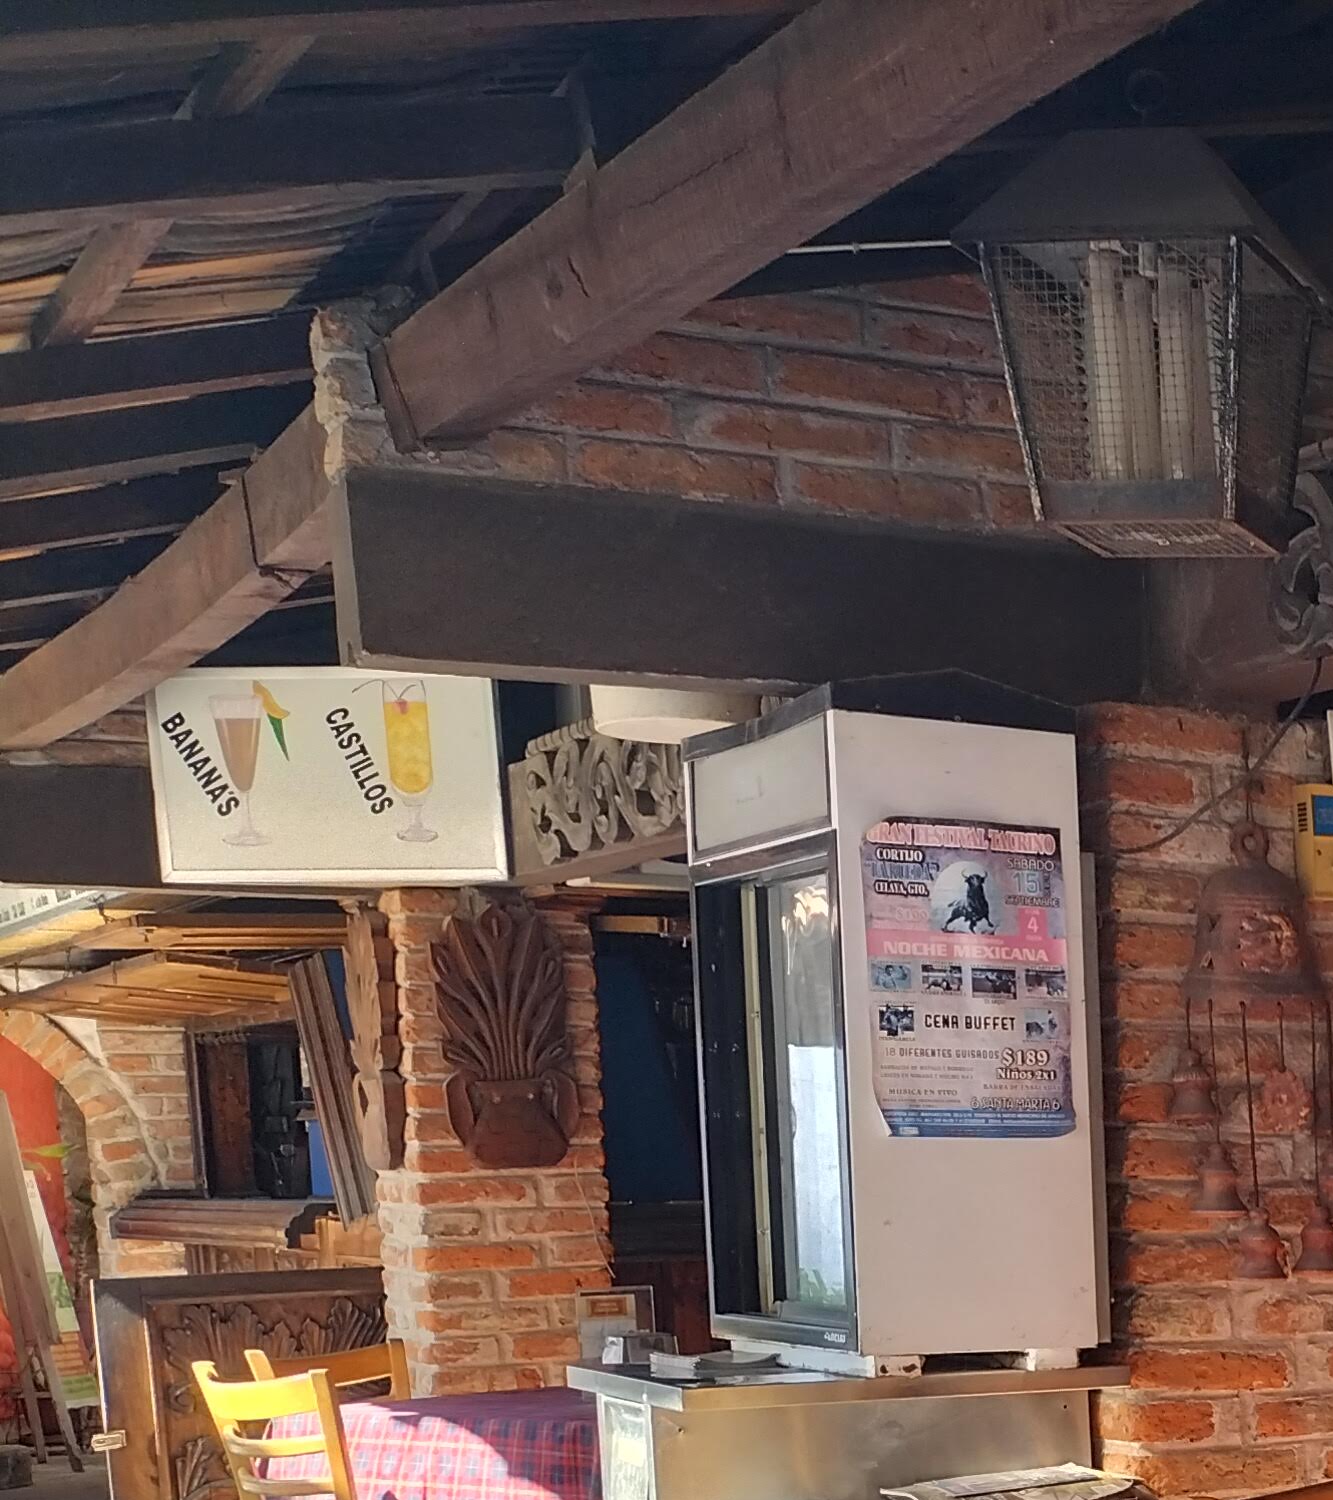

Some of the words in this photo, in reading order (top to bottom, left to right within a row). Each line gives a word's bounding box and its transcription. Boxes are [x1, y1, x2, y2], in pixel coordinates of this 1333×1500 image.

[160, 711, 241, 817] BANANA'S
[325, 707, 395, 815] CASTILLOS
[989, 829, 1056, 855] TAURINO
[876, 848, 923, 862] CORTIJO
[1008, 857, 1055, 871] SABADO
[875, 881, 907, 895] CELAYA,
[908, 884, 929, 896] GTO.
[1013, 871, 1038, 894] 15
[1027, 916, 1039, 933] 4
[883, 941, 947, 957] NOCHE
[953, 945, 1049, 962] MEXICANA
[924, 1014, 960, 1030] CENA
[965, 1015, 1016, 1032] BUFFET
[899, 1048, 952, 1058] DIFERENTES
[955, 1049, 1000, 1060] GUISADOS
[1001, 1047, 1049, 1067] $189
[996, 1068, 1033, 1080] Niños
[1034, 1069, 1057, 1081] 2x1
[982, 1096, 1014, 1110] SANTA
[1015, 1097, 1051, 1111] MARTA
